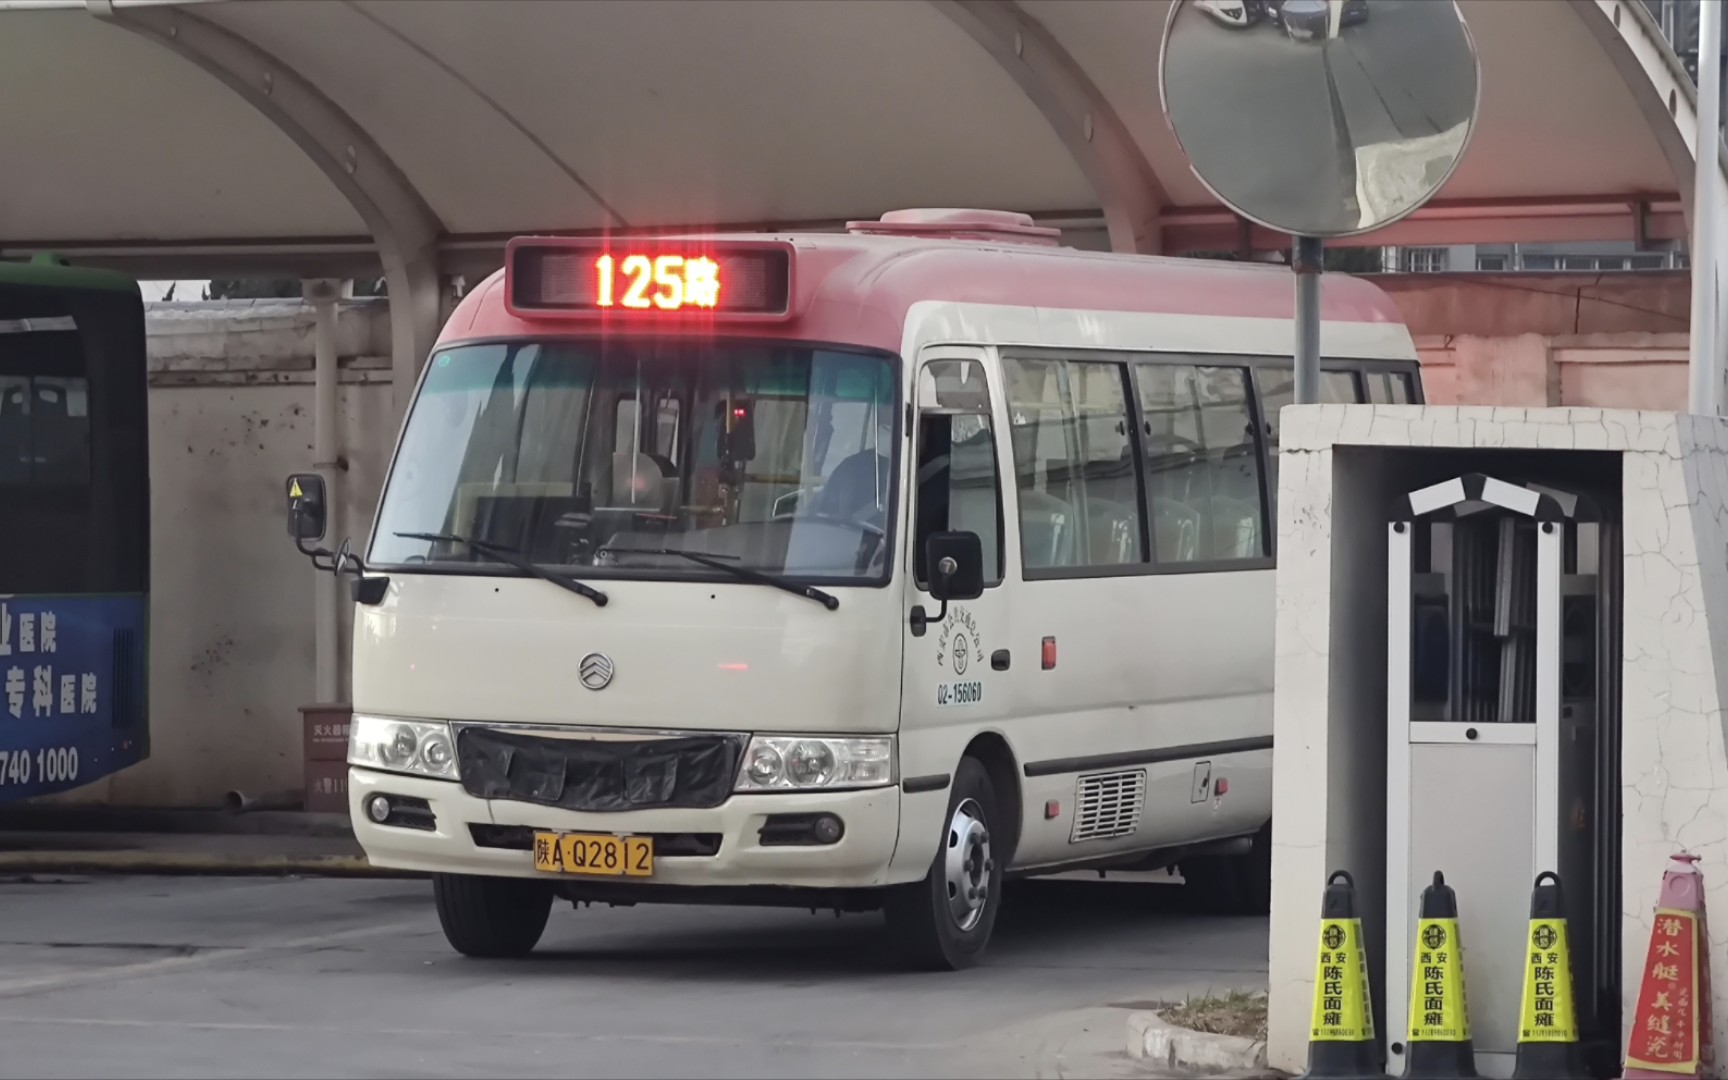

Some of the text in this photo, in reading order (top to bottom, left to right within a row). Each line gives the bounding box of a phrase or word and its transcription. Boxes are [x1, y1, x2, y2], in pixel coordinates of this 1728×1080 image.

[5, 665, 97, 718] 专科医院
[937, 682, 982, 704] 02-156060
[37, 747, 78, 783] 1000
[1321, 952, 1346, 963] 西安
[1421, 952, 1447, 963] 西安
[1531, 952, 1558, 964] 西安
[1651, 917, 1683, 981] 潜水艇
[1323, 966, 1342, 1025] 陈氏面瘫
[1424, 966, 1443, 1025] 陈氏面瘫
[1534, 966, 1554, 1026] 陈氏面瘫
